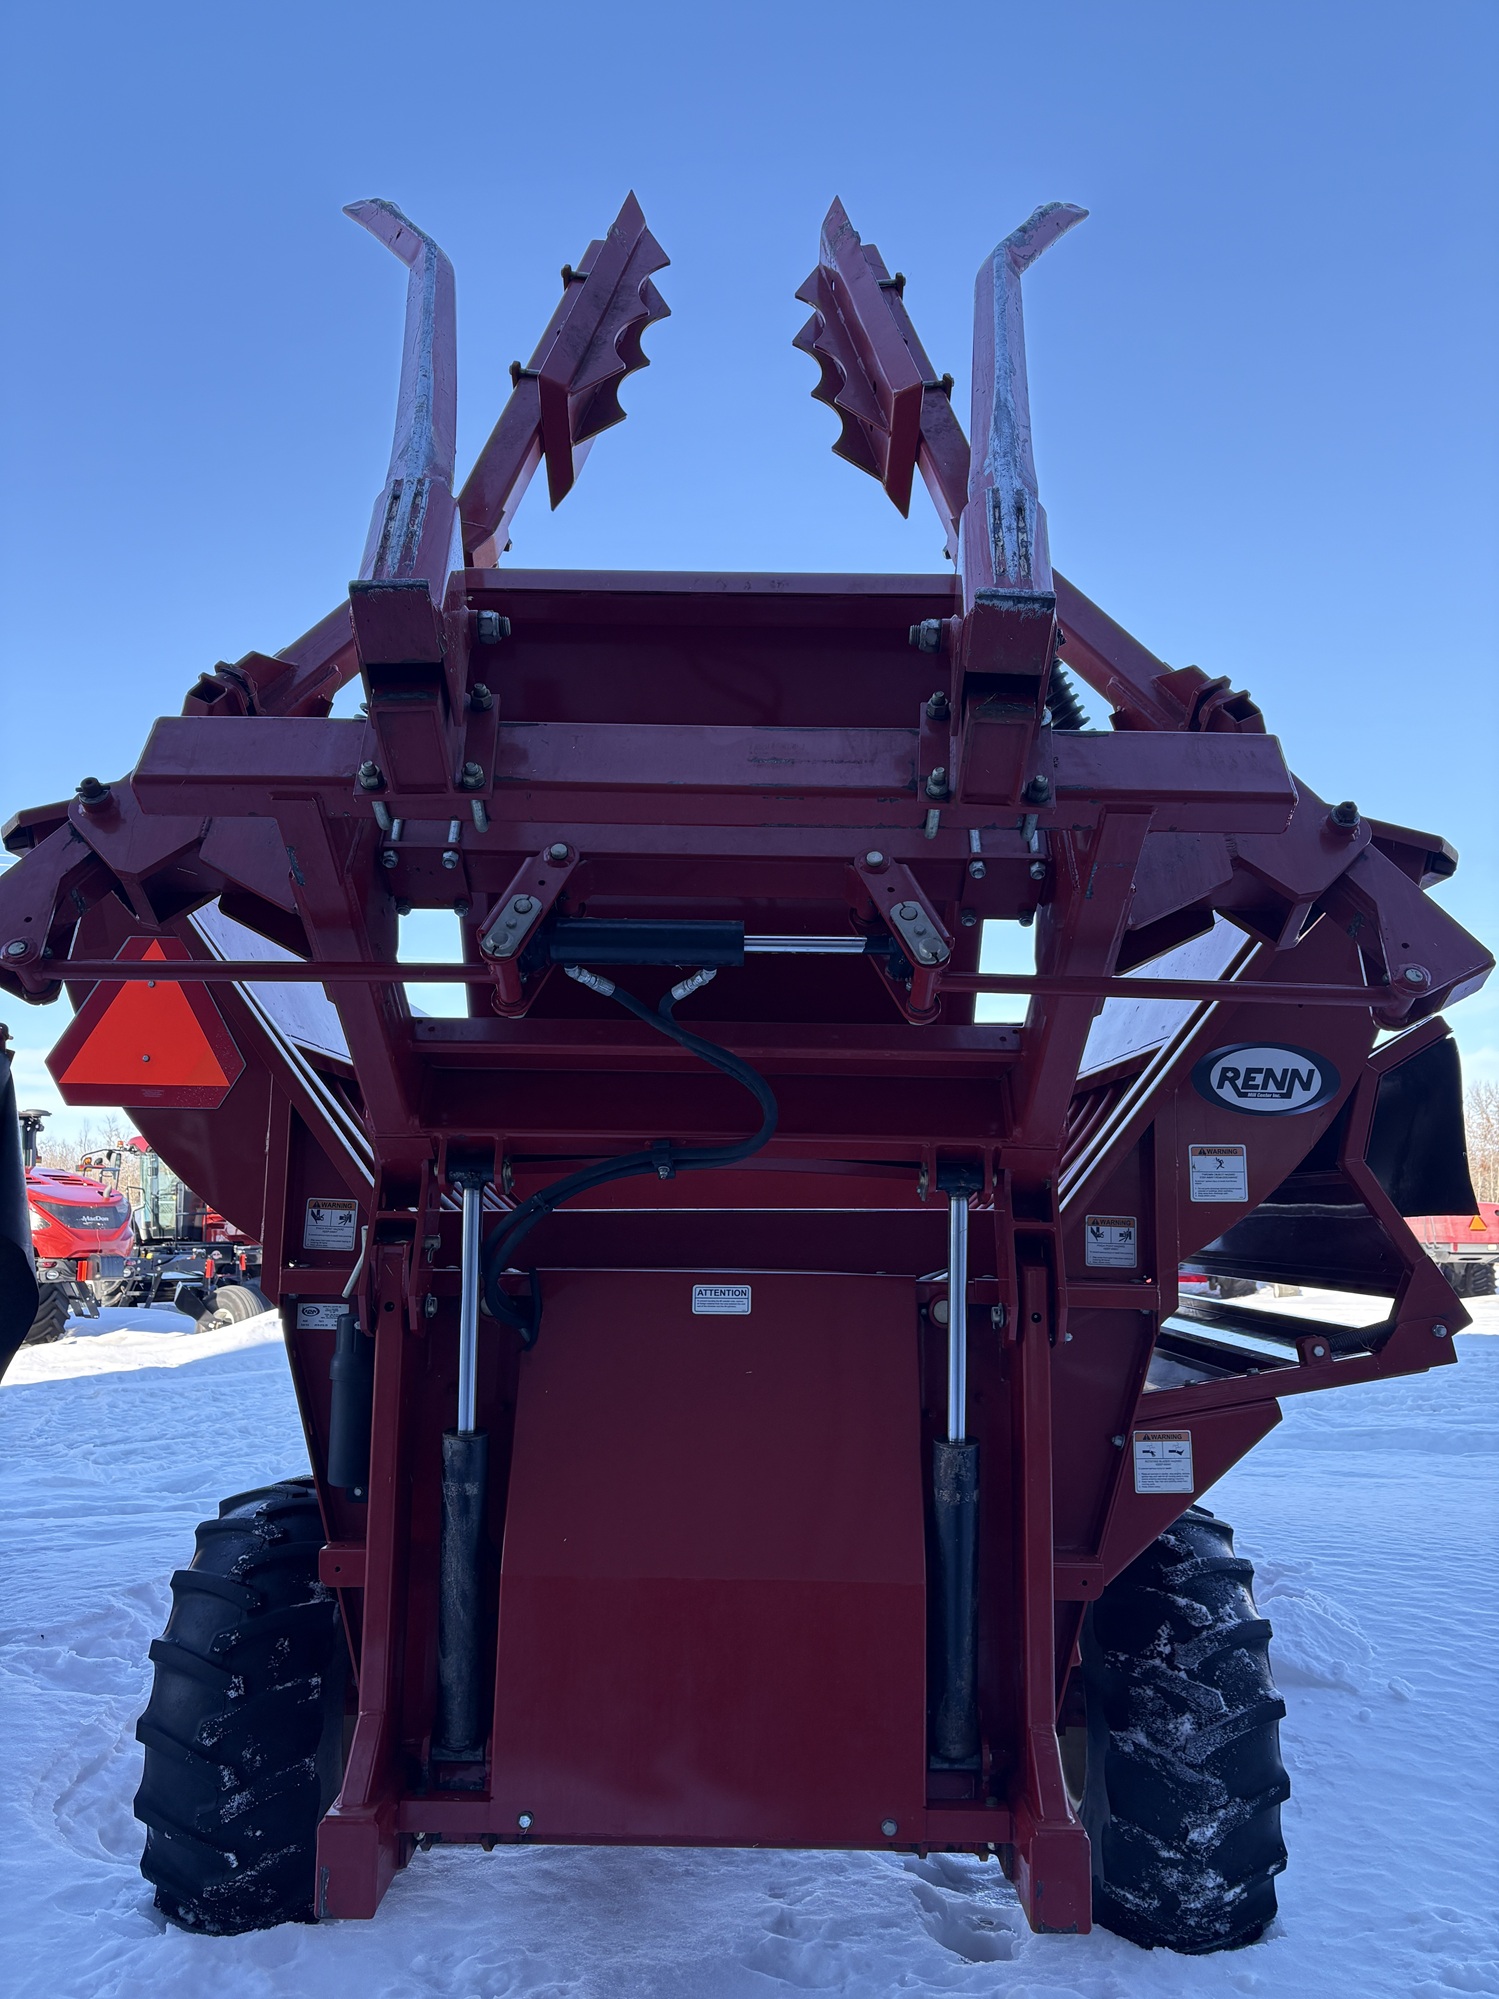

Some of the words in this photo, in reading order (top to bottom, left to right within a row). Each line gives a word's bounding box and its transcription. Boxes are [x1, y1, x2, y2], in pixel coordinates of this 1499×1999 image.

[1216, 1066, 1316, 1099] RENN
[321, 1201, 352, 1209] WARNING
[81, 1215, 109, 1223] MacDon
[696, 1289, 747, 1297] ATTENTION
